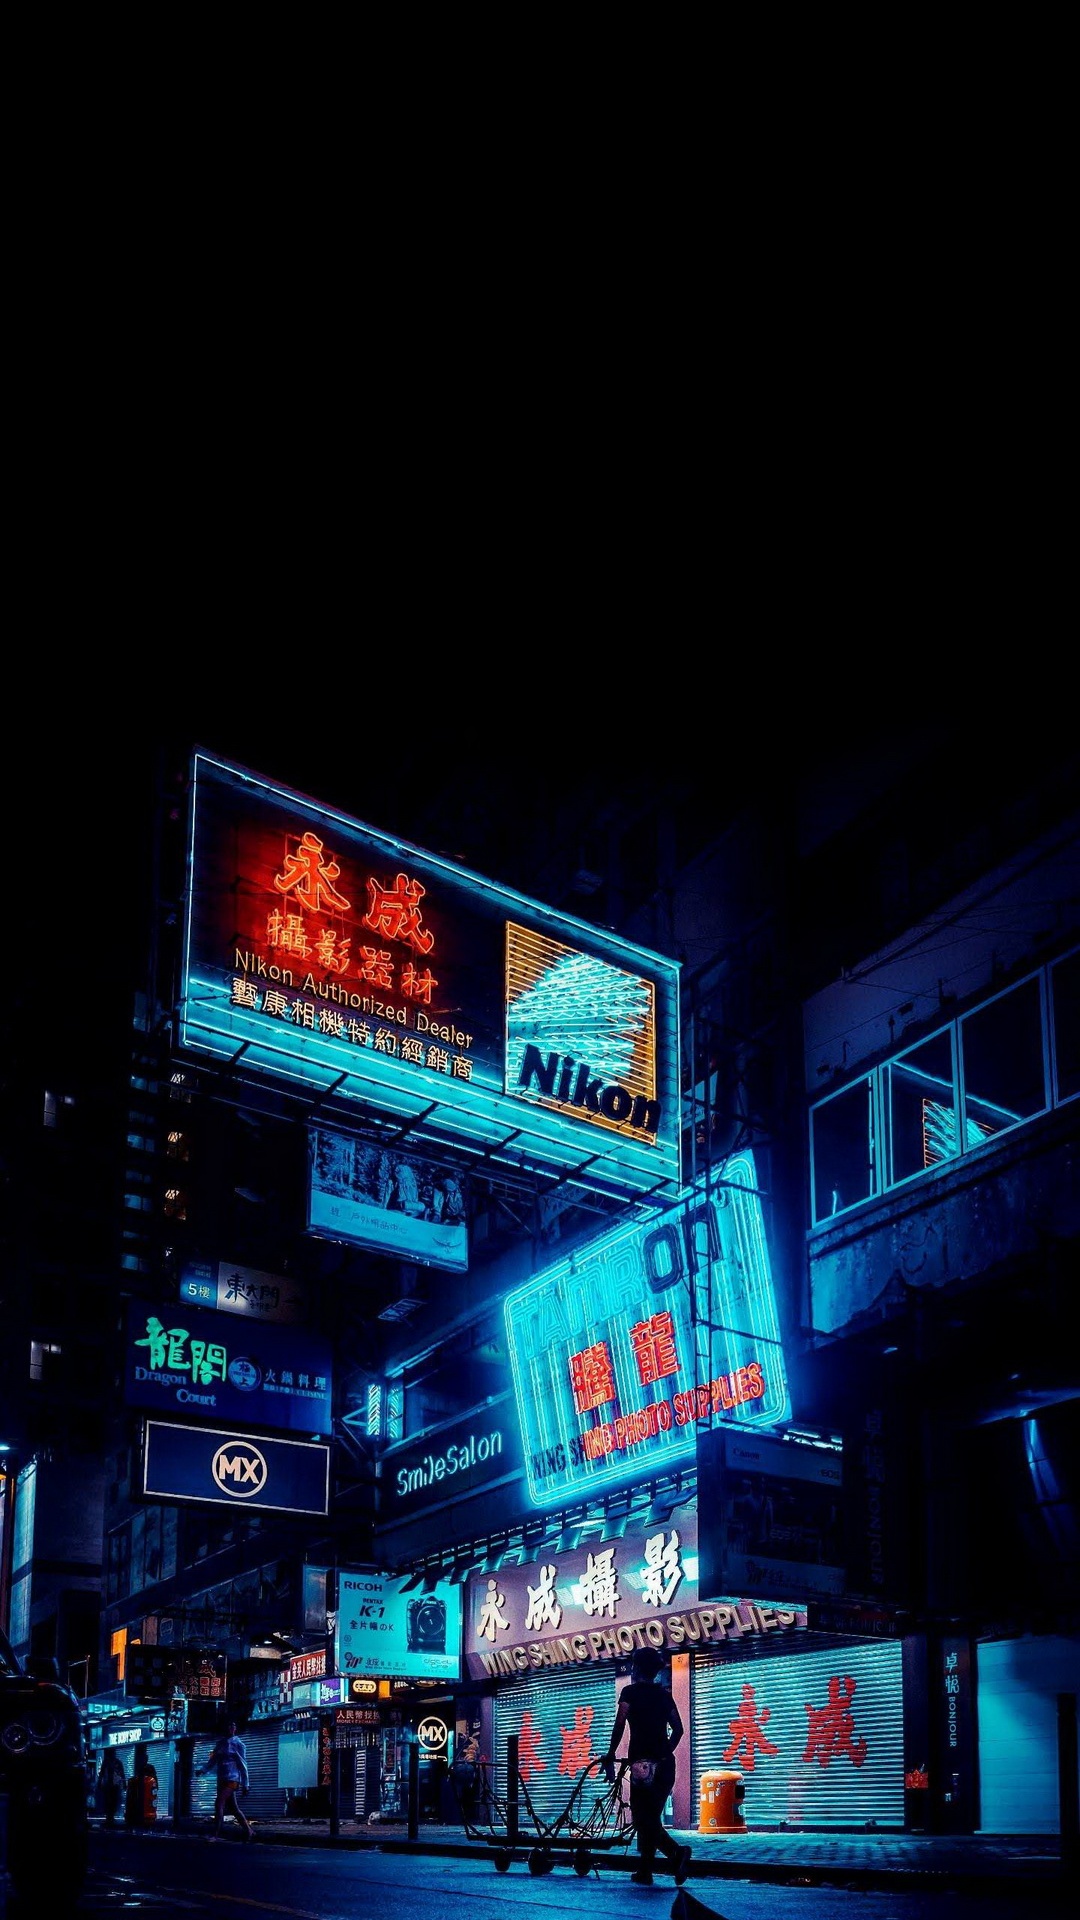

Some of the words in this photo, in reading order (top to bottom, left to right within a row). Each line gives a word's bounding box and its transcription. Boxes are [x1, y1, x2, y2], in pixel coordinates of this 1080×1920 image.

[273, 832, 435, 954] 永成
[234, 947, 294, 986] Nikon
[302, 971, 408, 1026] Authorized
[415, 1011, 473, 1050] Dealer
[231, 976, 475, 1083] 藝康相機特約經銷商
[519, 1043, 664, 1135] Nikon
[134, 1366, 187, 1387] Dragon
[264, 1369, 327, 1392] 火鍋料理
[568, 1311, 681, 1415] 騰龍
[175, 1388, 217, 1407] Court
[615, 1400, 672, 1448] PHOTO
[673, 1361, 766, 1426] SUPPLIES
[217, 1454, 260, 1485] MX
[731, 1446, 761, 1461] Canon
[343, 1580, 383, 1592] RICOH
[359, 1605, 385, 1618] K-1
[475, 1528, 686, 1642] 永成攝影
[480, 1649, 528, 1676] WING
[528, 1634, 588, 1670] SHING
[589, 1620, 664, 1657] PHOTO
[667, 1605, 797, 1646] SUPPLIES
[421, 1726, 444, 1742] MX
[947, 1695, 959, 1748] BONJOUR
